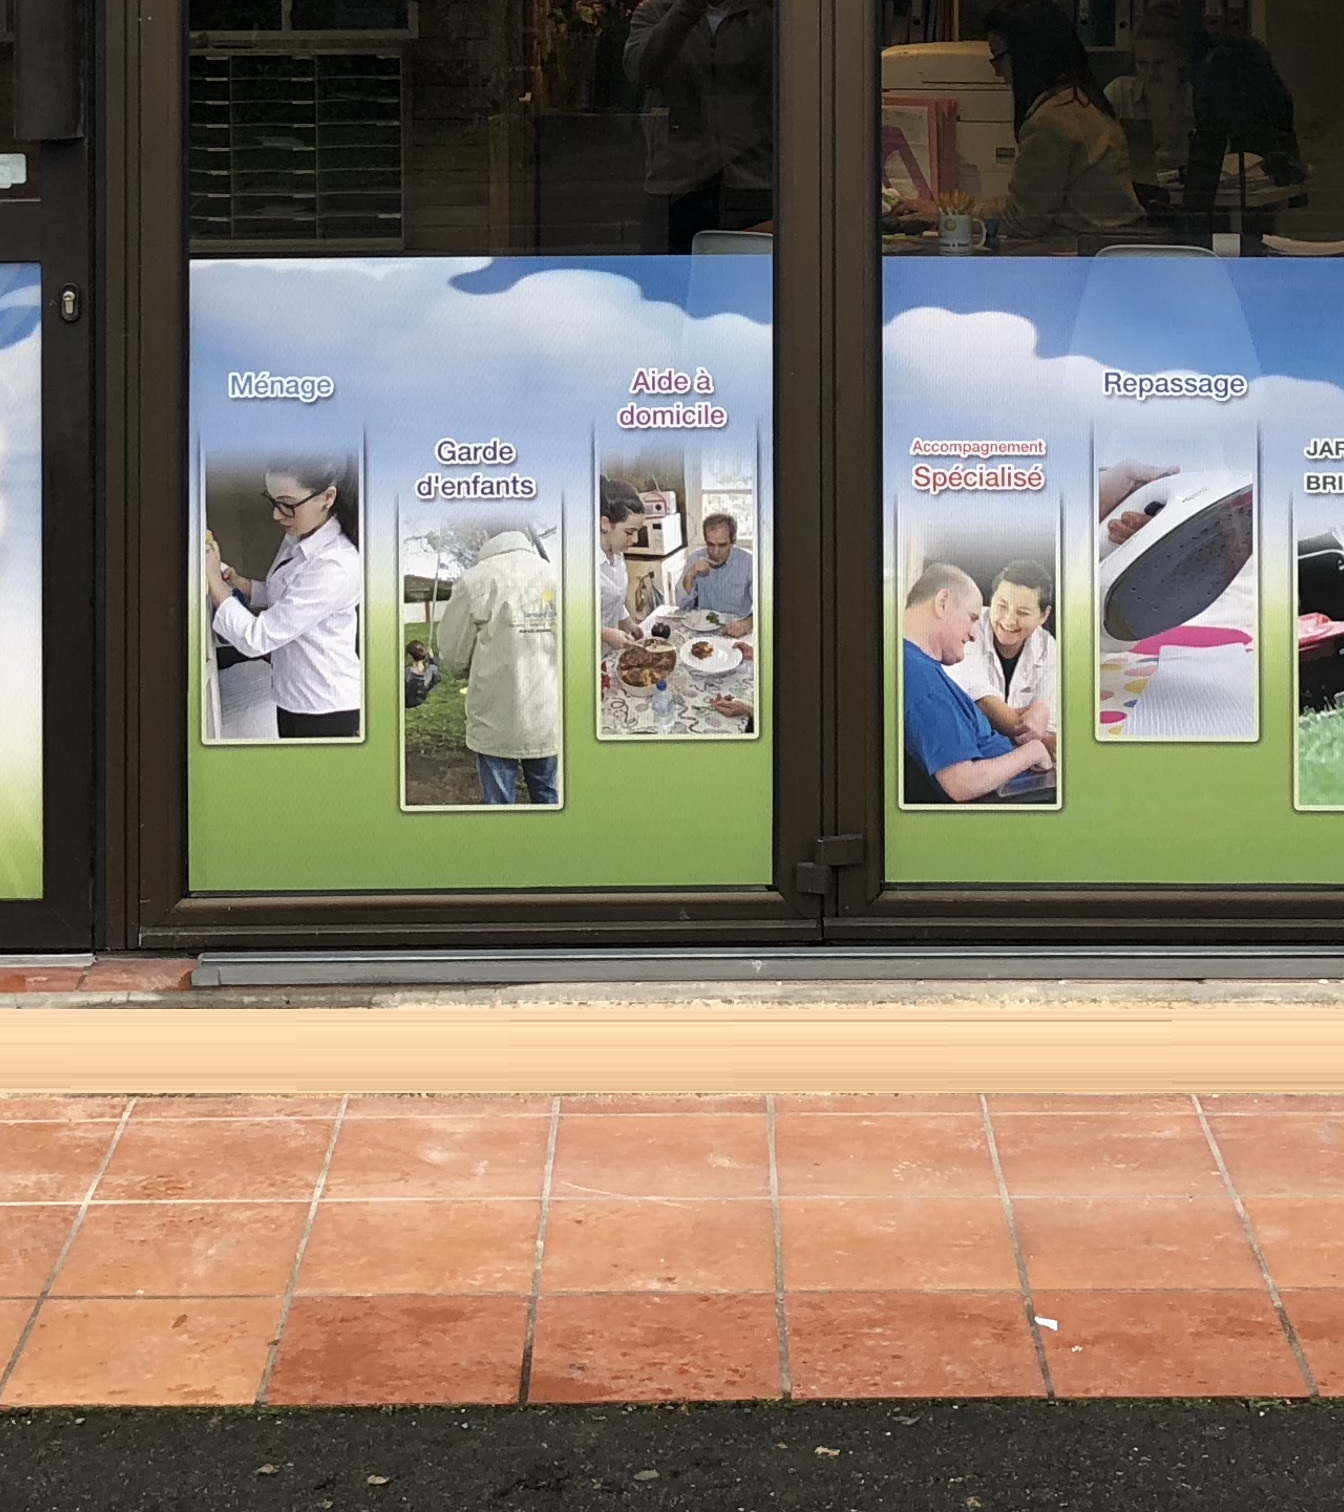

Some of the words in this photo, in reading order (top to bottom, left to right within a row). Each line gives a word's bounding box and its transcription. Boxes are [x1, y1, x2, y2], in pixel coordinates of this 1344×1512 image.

[229, 374, 334, 401] Ménage
[631, 369, 690, 393] Aide
[697, 368, 713, 393] à
[1103, 372, 1247, 398] Repassage
[617, 403, 727, 428] domicile
[435, 440, 515, 463] Garde
[911, 440, 1045, 456] Accompagnement
[416, 475, 535, 499] d'enfants
[913, 465, 1043, 491] Spécialisé
